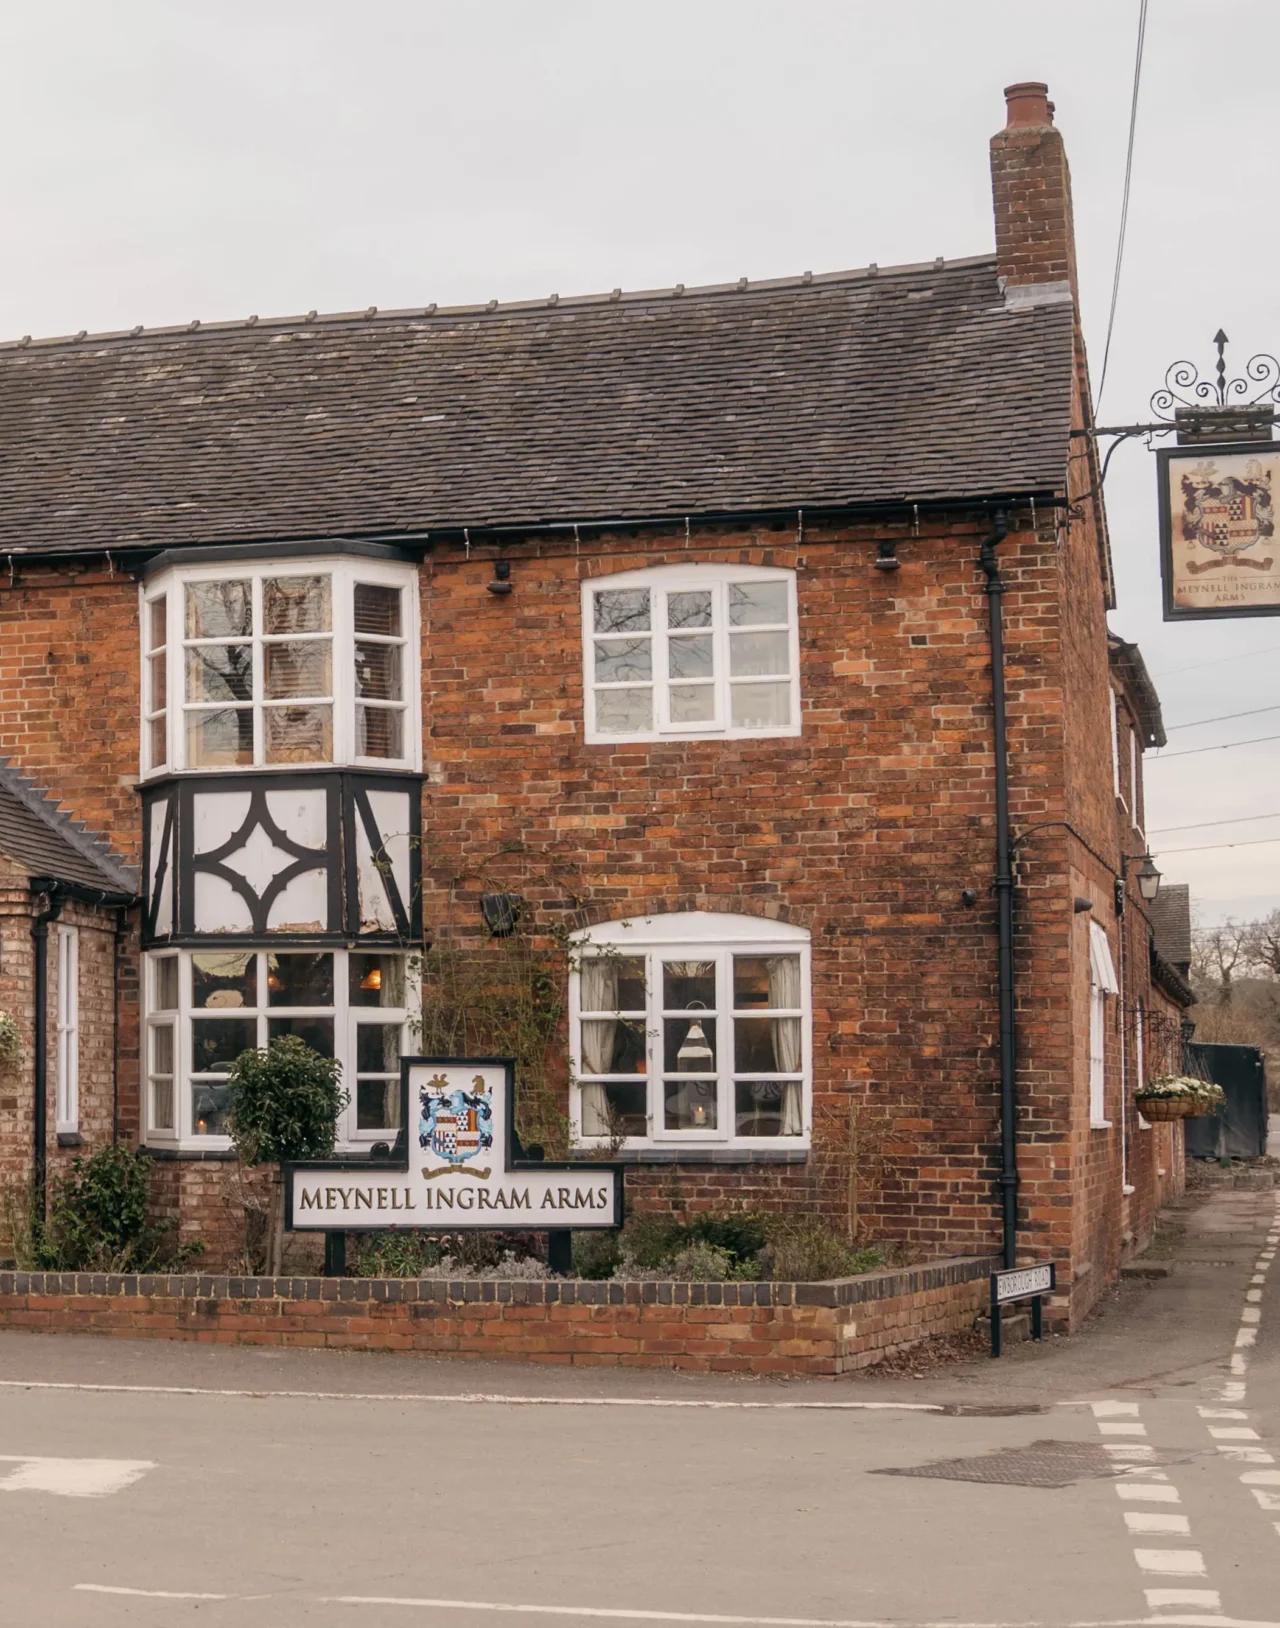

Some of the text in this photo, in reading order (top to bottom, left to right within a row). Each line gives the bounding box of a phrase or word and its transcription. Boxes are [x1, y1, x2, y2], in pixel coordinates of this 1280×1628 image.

[1177, 583, 1228, 594] MEYNELL
[1214, 593, 1246, 602] ARMS
[299, 1187, 608, 1210] MEYNELL INGRAM ARMS
[998, 1272, 1032, 1296] EWBOROUGH
